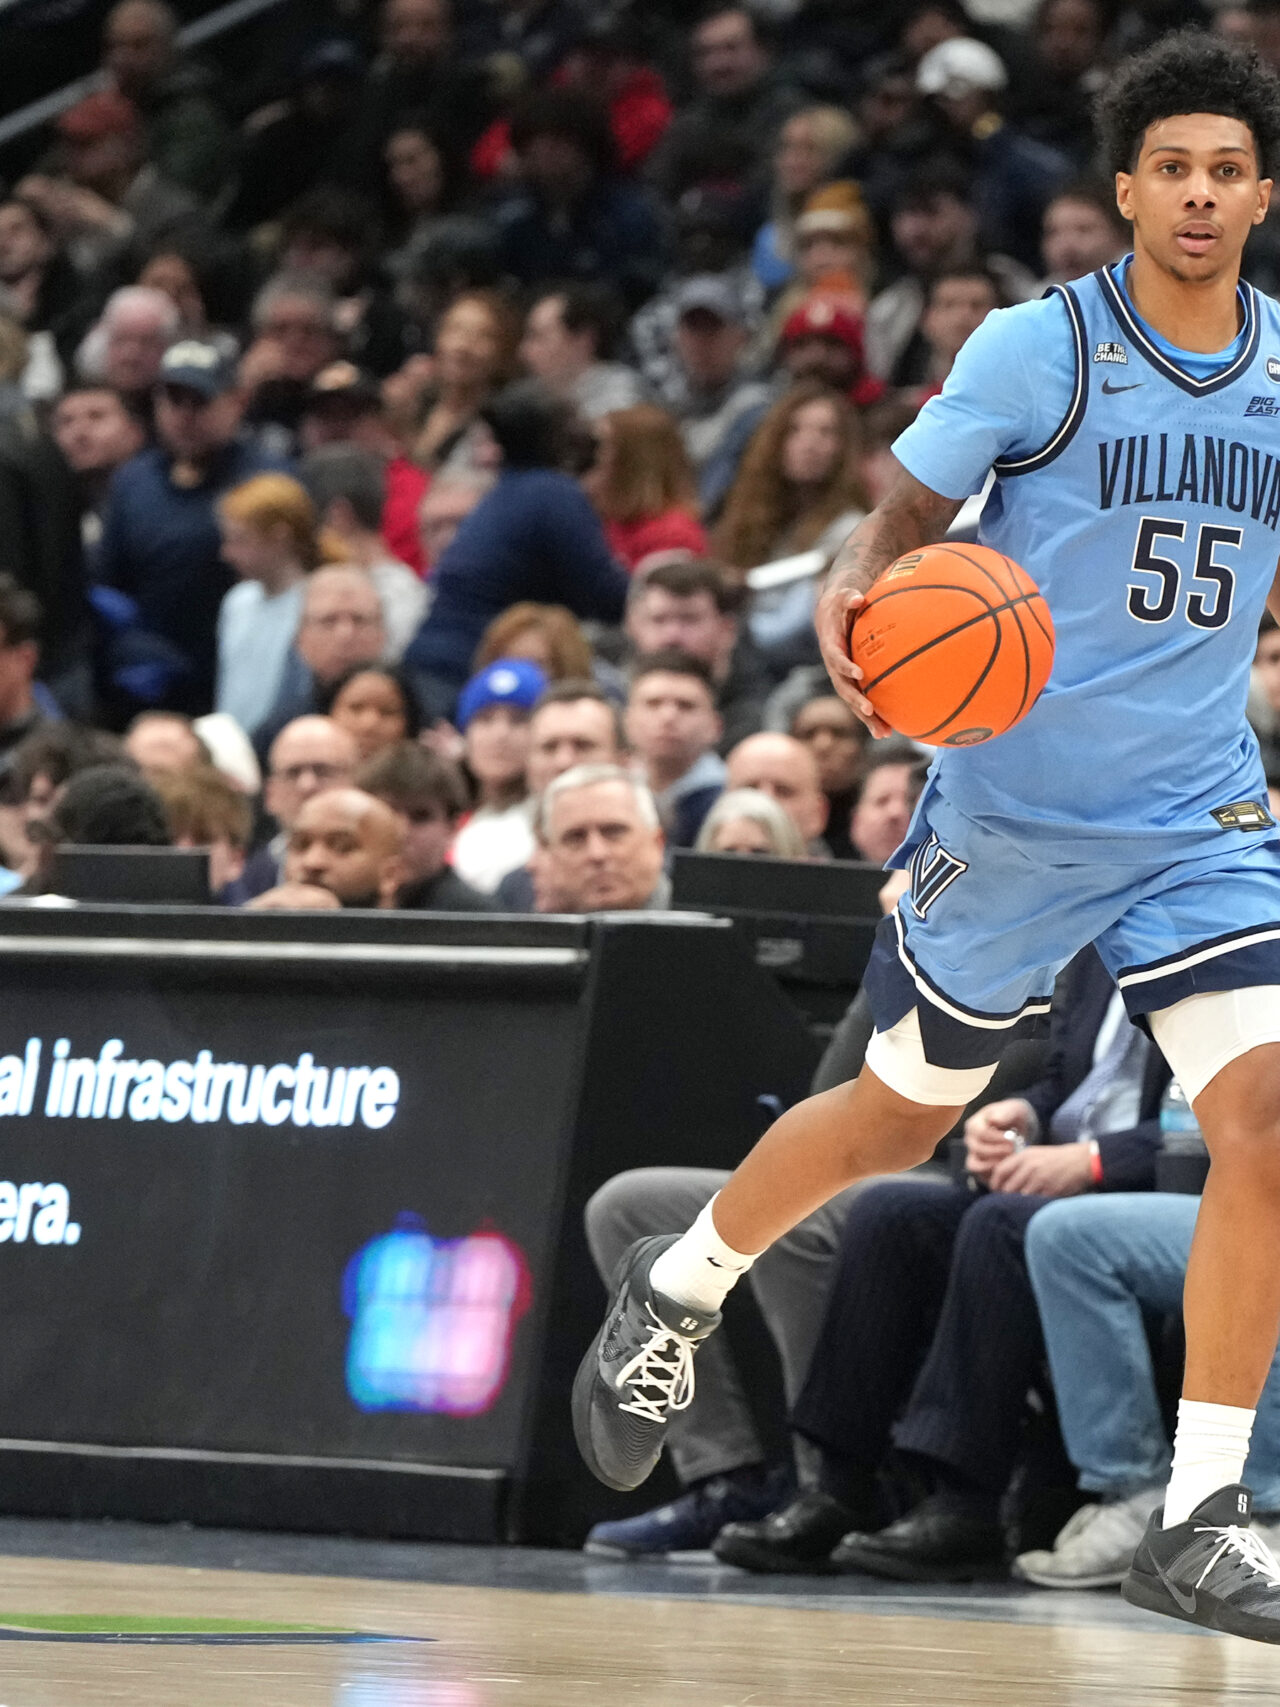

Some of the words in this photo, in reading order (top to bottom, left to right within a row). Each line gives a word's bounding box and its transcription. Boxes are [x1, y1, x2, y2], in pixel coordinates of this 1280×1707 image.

[1097, 343, 1111, 353] BE
[1094, 352, 1128, 364] CHANGE
[1250, 396, 1276, 406] BIG
[1245, 405, 1280, 415] EAST
[1126, 516, 1244, 630] 55
[45, 1038, 400, 1129] infrastructure
